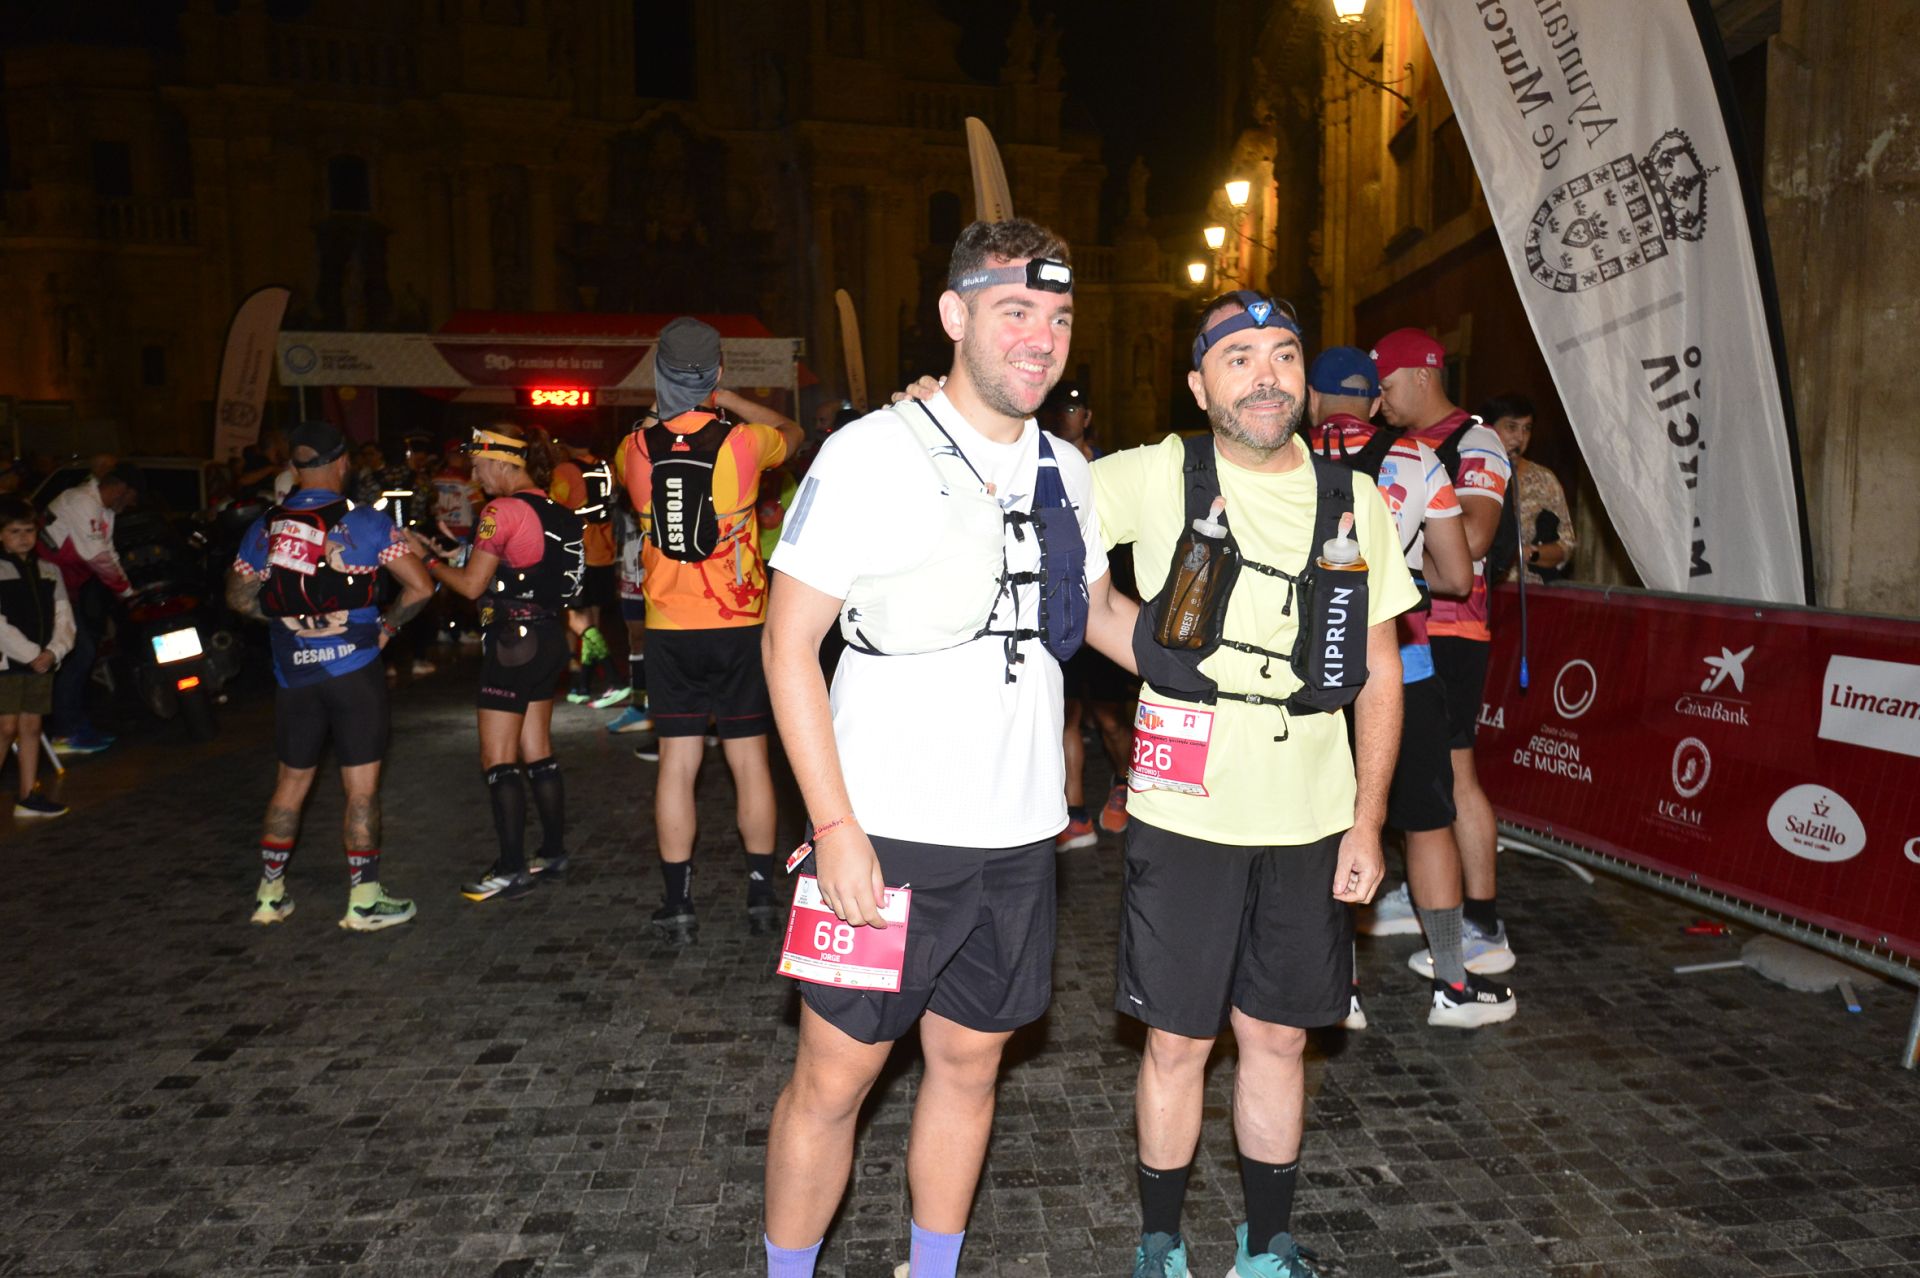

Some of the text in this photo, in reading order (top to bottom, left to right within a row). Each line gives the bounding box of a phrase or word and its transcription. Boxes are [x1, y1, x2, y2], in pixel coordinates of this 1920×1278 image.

[962, 275, 989, 287] Blukar
[665, 477, 686, 553] UTOBEST
[1323, 587, 1354, 687] KIPRUN
[1674, 697, 1750, 726] CaixaBank
[1133, 737, 1172, 771] 326
[1513, 748, 1592, 783] DE MURCIA
[1658, 799, 1702, 825] UCAM
[1785, 814, 1846, 845] Salzillo
[813, 920, 856, 955] 68
[820, 952, 841, 963] JORGE
[1477, 991, 1498, 1004] HOKA
